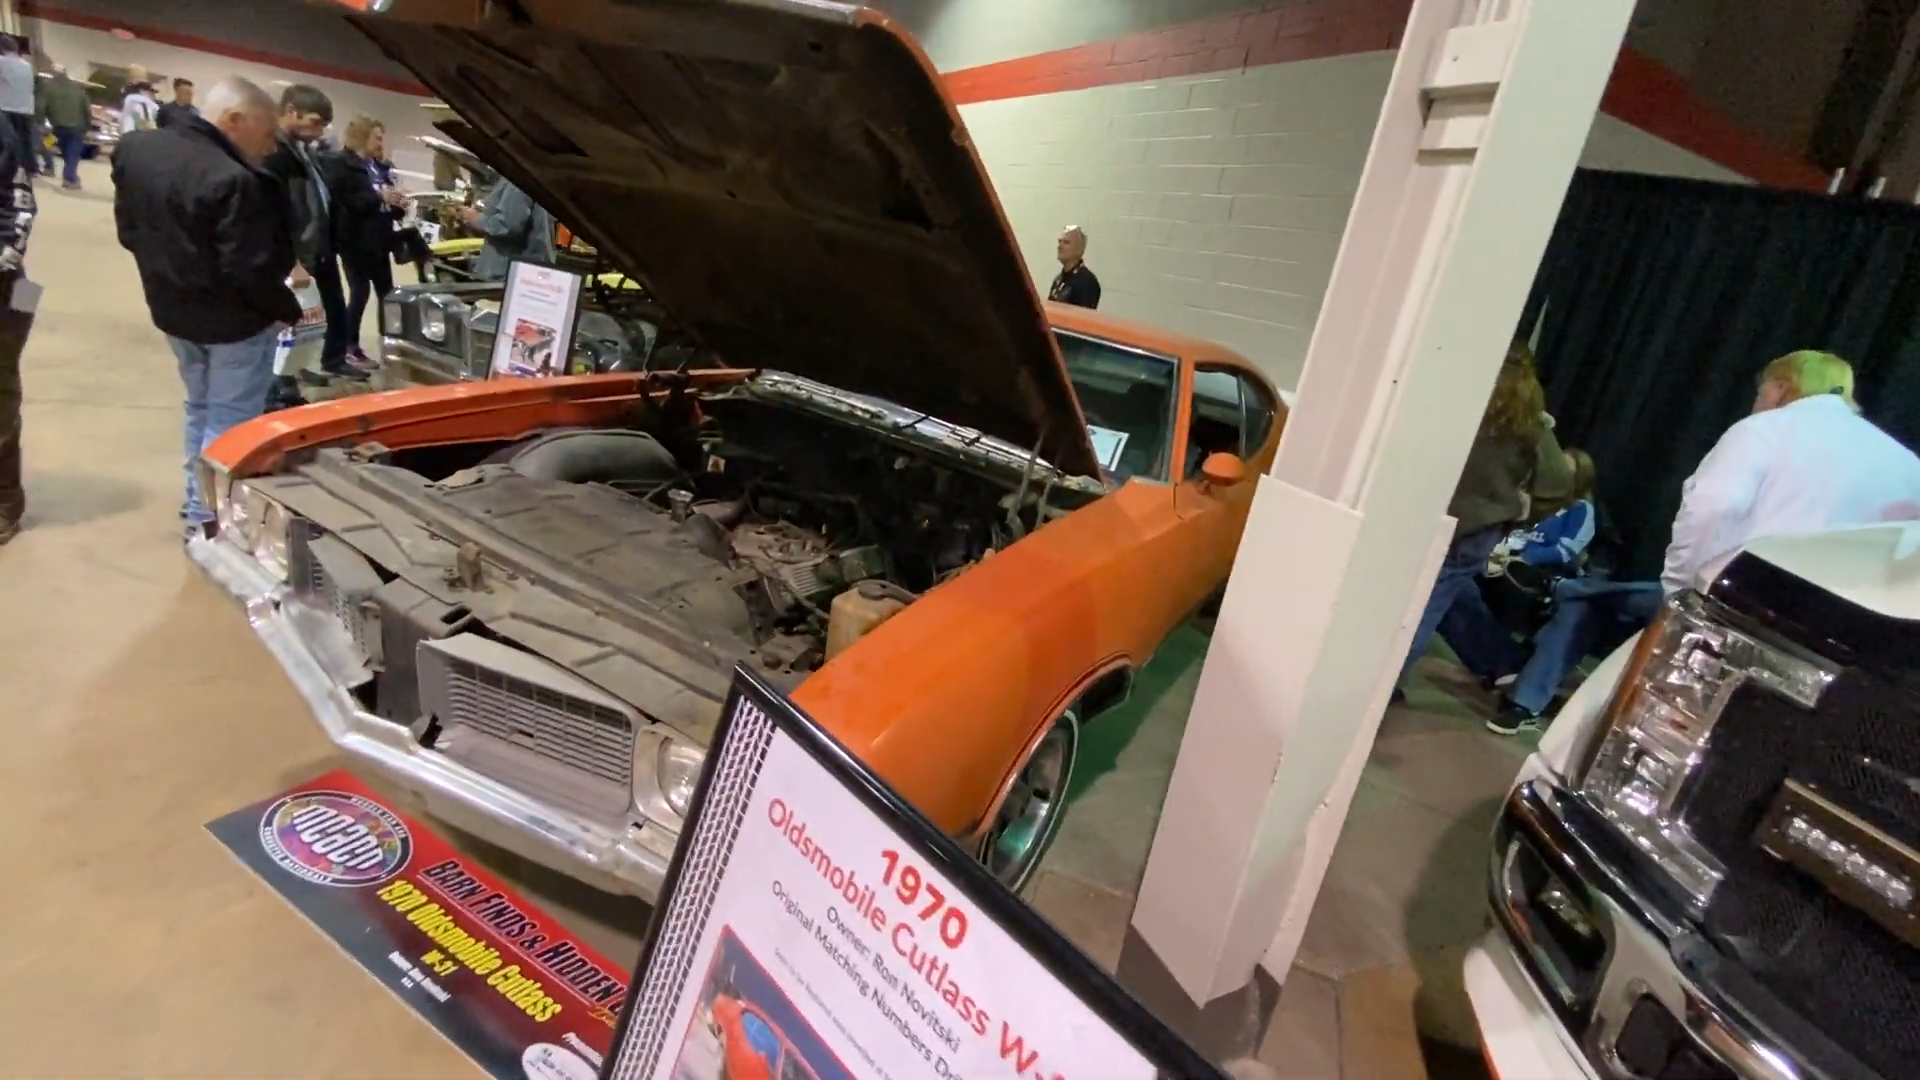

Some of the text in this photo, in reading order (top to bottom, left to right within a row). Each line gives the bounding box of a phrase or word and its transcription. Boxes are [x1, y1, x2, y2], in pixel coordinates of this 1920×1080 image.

[376, 879, 429, 913] 1970
[406, 902, 503, 976] Oldsmobile
[486, 964, 563, 1022] Cutlass
[421, 860, 626, 1004] BARN FINDS & HIDDEN
[768, 798, 887, 934] Oldsmobile
[892, 922, 991, 1036] Cutlass
[1000, 1020, 1065, 1080] W-
[772, 879, 815, 933] Original
[814, 925, 871, 998] Matching
[871, 986, 934, 1062] Numbers
[881, 849, 968, 949] 1970
[826, 905, 872, 962] Owner:
[900, 981, 961, 1055] Novitski
